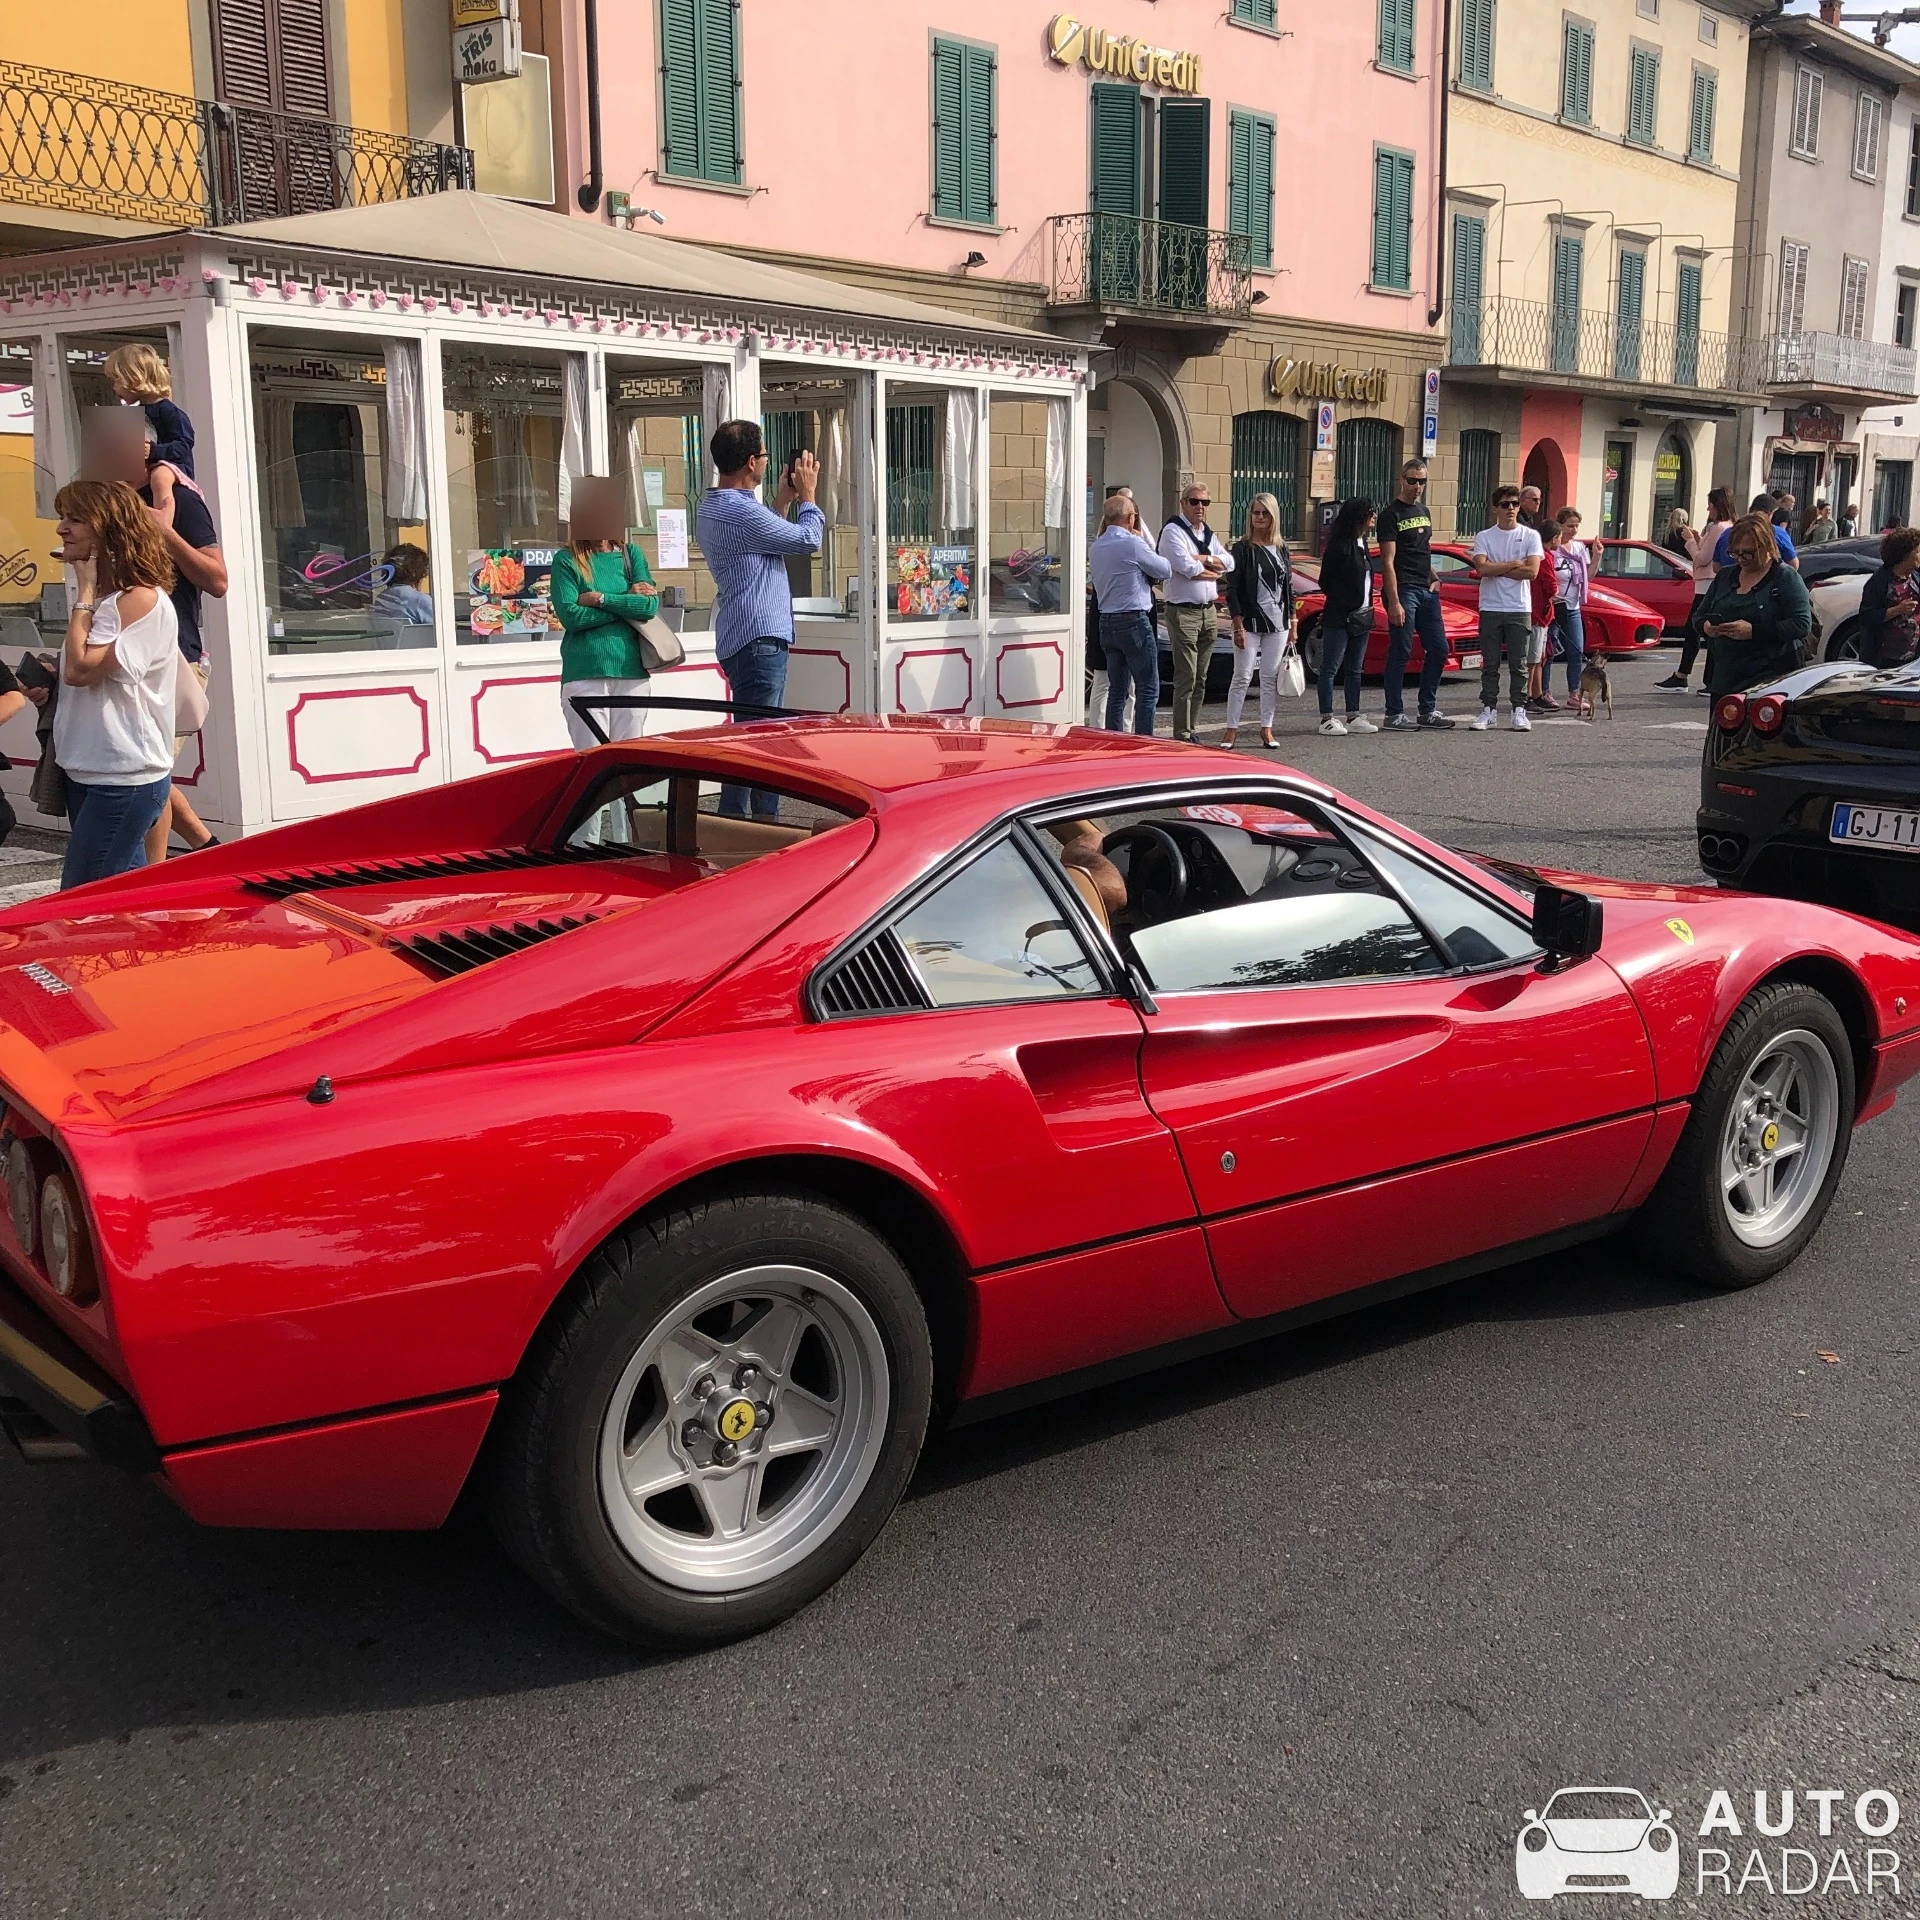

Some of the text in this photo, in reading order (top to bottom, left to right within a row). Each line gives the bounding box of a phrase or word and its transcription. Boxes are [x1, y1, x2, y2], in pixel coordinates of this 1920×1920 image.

[462, 27, 493, 65] TRIS
[463, 58, 497, 77] moka
[1087, 26, 1203, 94] UniCredit
[1299, 360, 1388, 402] UniCredit
[1427, 421, 1435, 437] P
[1323, 508, 1334, 525] P
[525, 550, 557, 565] PRA
[933, 549, 967, 562] APERITIVI
